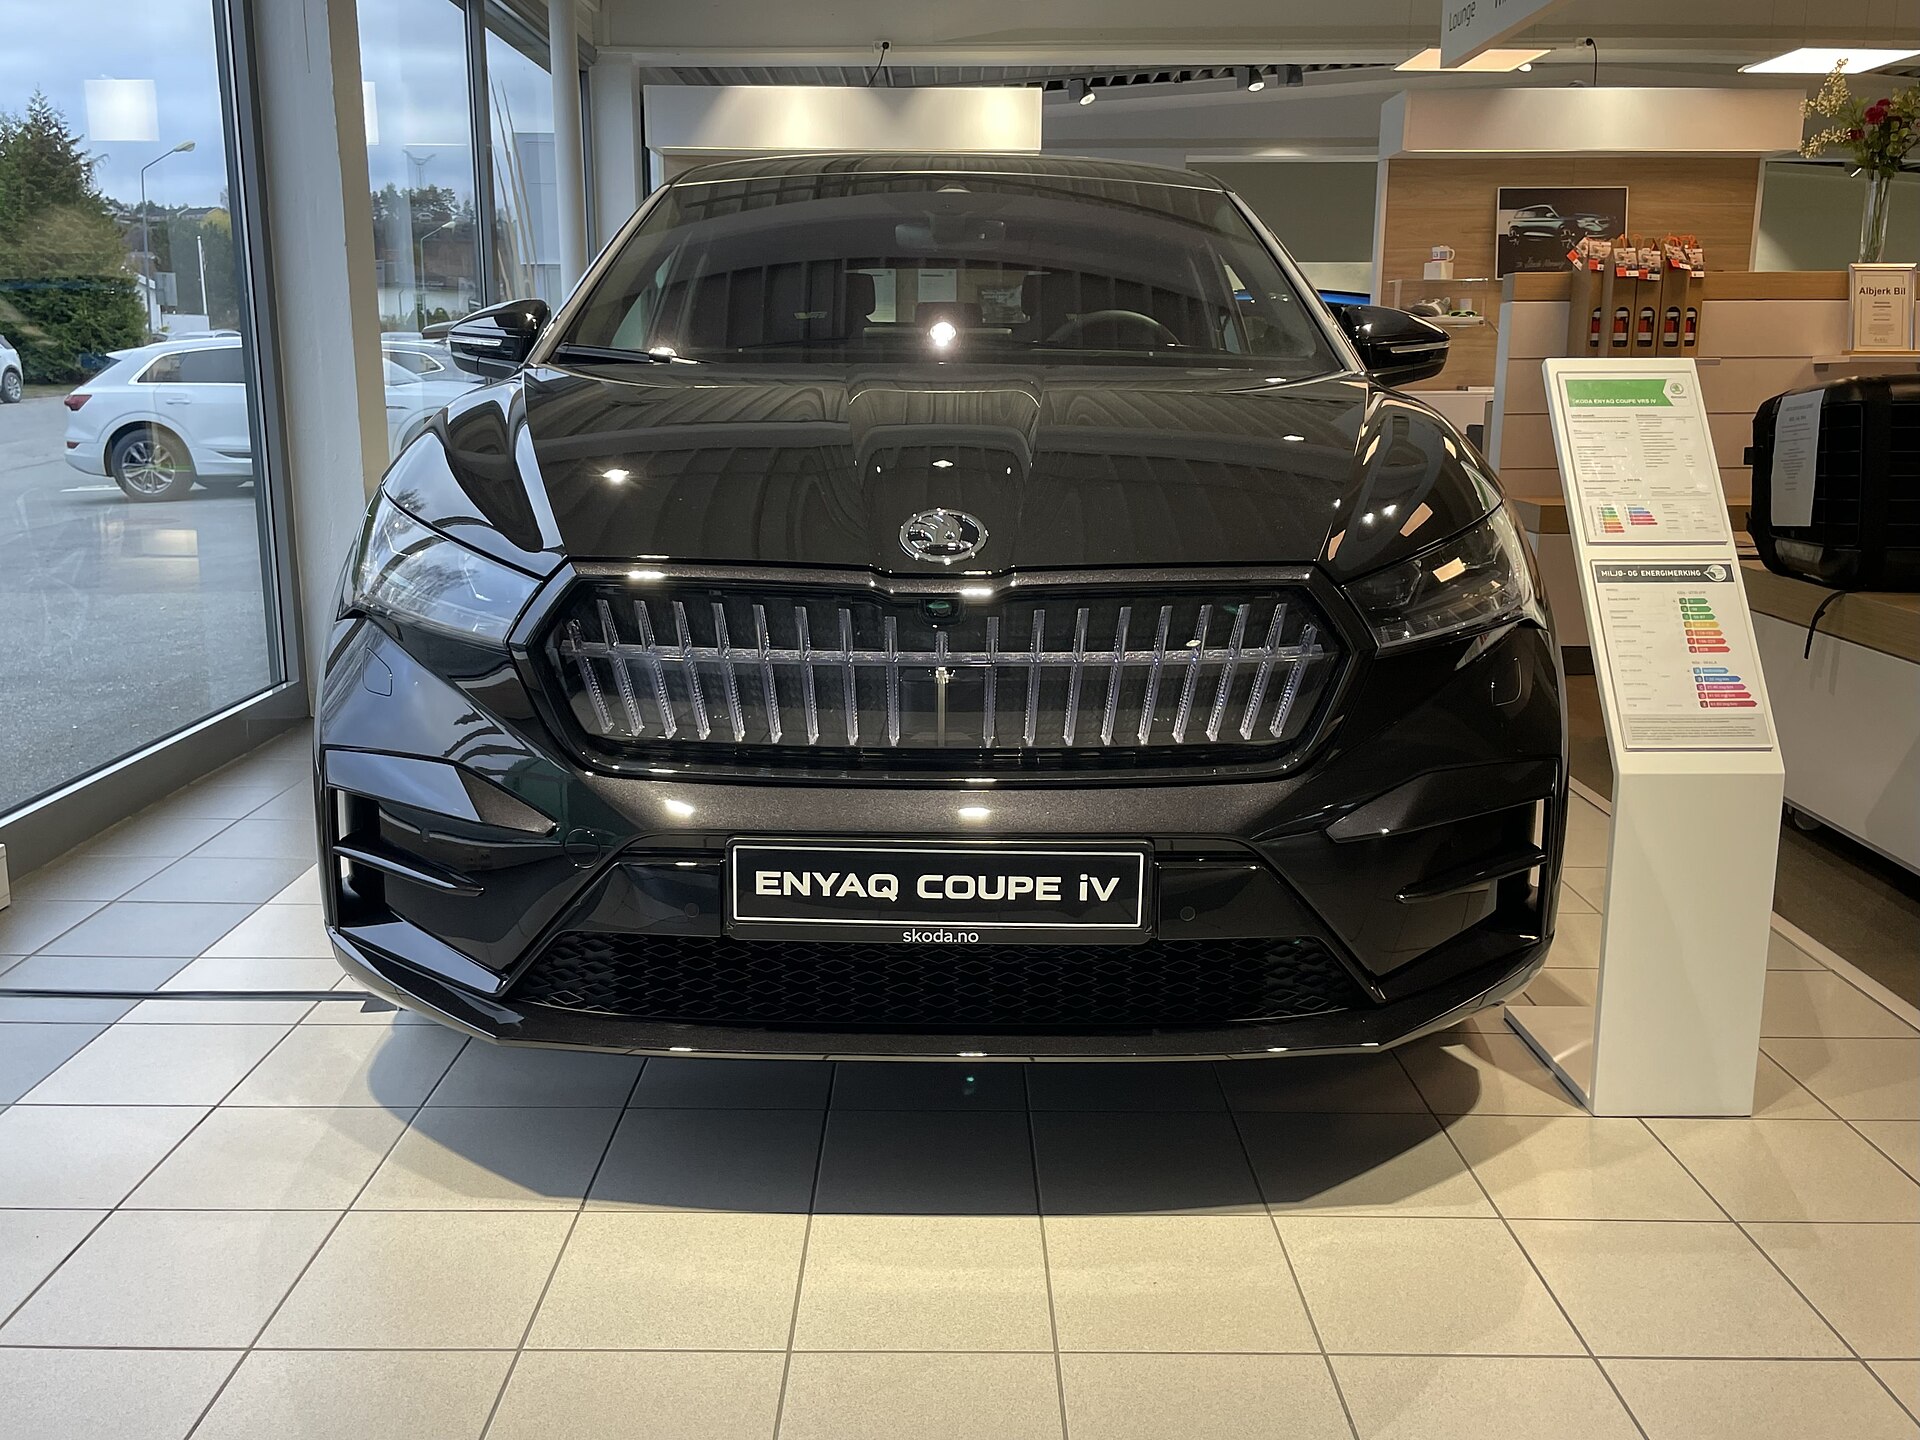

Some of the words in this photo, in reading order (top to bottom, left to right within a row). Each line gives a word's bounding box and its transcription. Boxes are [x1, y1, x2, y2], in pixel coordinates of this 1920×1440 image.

[1449, 1, 1476, 32] Lounge
[1859, 286, 1891, 296] Albjerk
[1893, 287, 1906, 295] Bil
[1641, 569, 1701, 577] ENERGIMERKING
[755, 870, 899, 902] ENYAQ
[917, 874, 1062, 902] COUPE
[1078, 873, 1120, 902] iV
[902, 928, 979, 944] skoda.no
